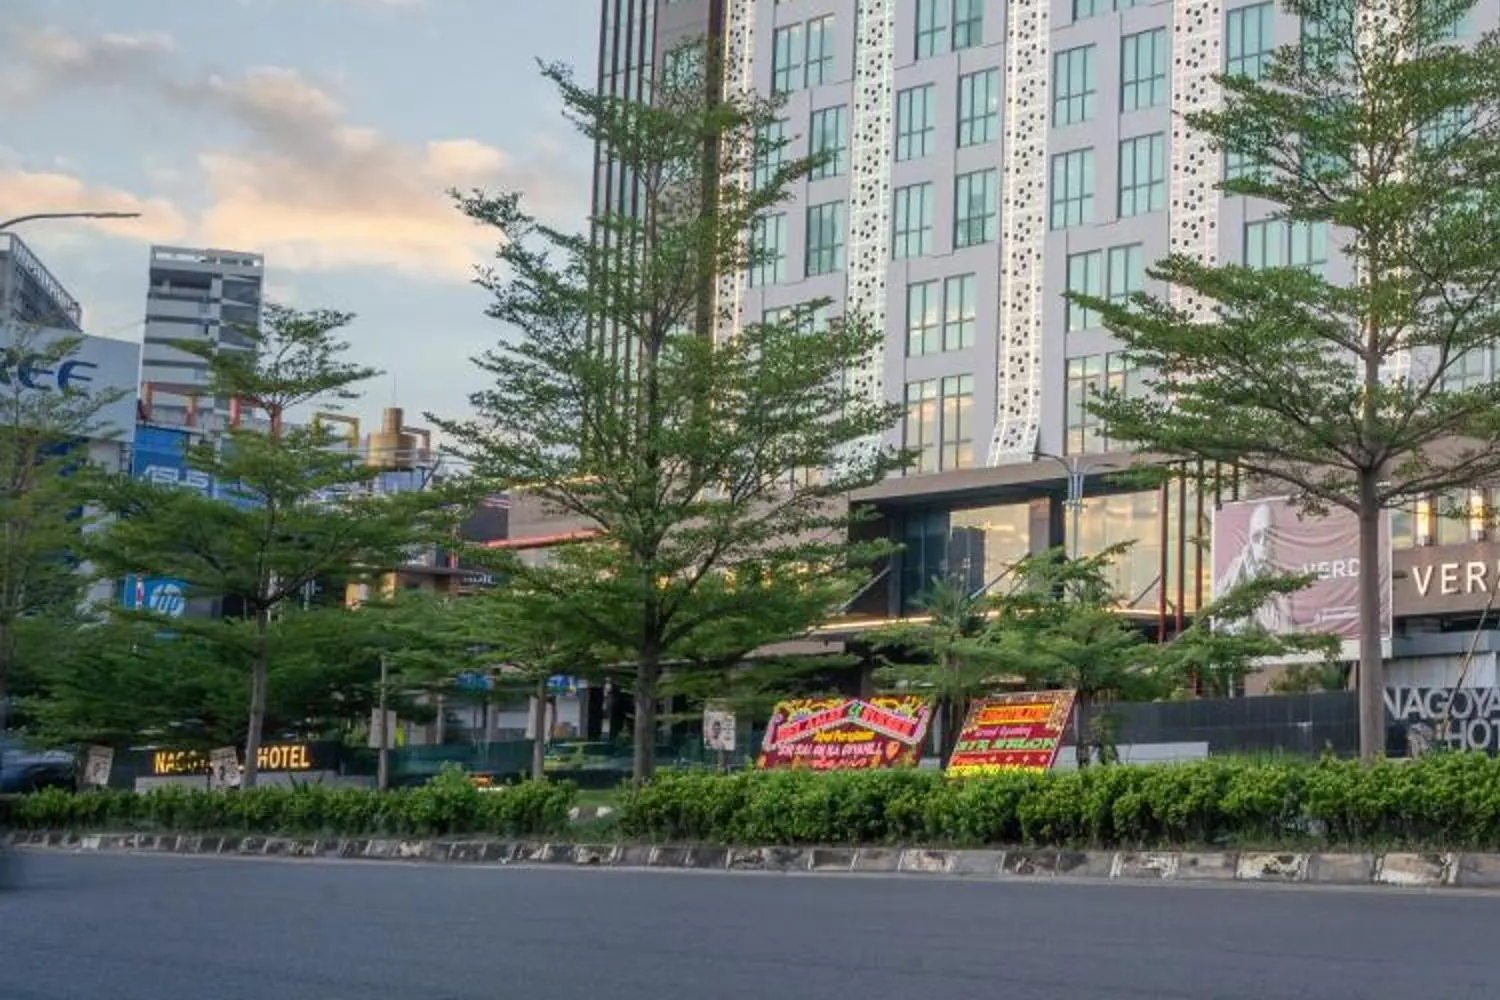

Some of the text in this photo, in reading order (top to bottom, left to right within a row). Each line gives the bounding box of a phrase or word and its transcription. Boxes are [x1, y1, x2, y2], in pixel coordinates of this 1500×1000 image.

[1302, 557, 1361, 580] VERD
[154, 750, 212, 774] NAGO
[257, 745, 310, 769] HOTEL
